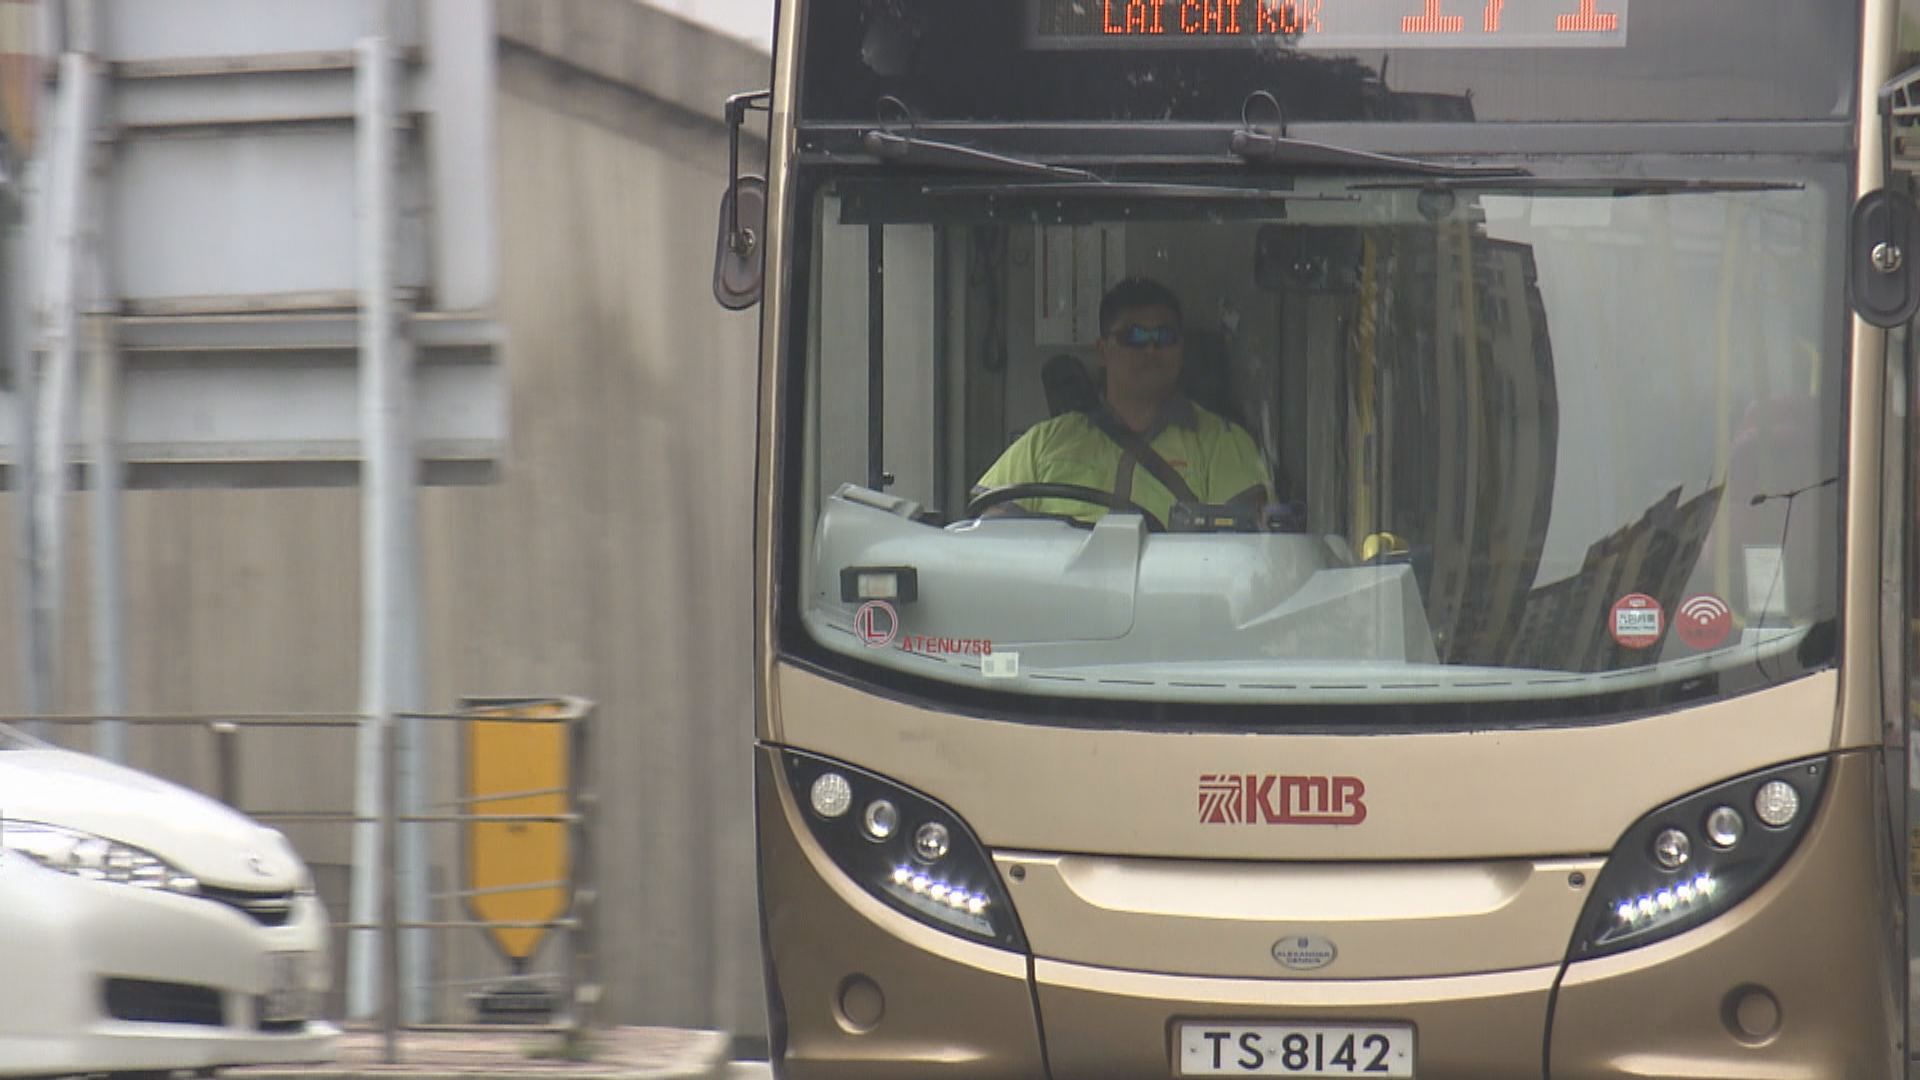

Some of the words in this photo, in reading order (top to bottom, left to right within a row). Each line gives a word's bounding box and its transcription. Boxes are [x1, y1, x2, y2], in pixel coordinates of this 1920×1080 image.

[1103, 0, 1164, 34] LAI
[1180, 0, 1240, 34] CHI
[1256, 0, 1323, 34] KOK
[902, 635, 992, 655] ATENU758
[1246, 775, 1367, 825] KMB
[1204, 1032, 1265, 1070] TS
[1281, 1033, 1391, 1072] 8142
